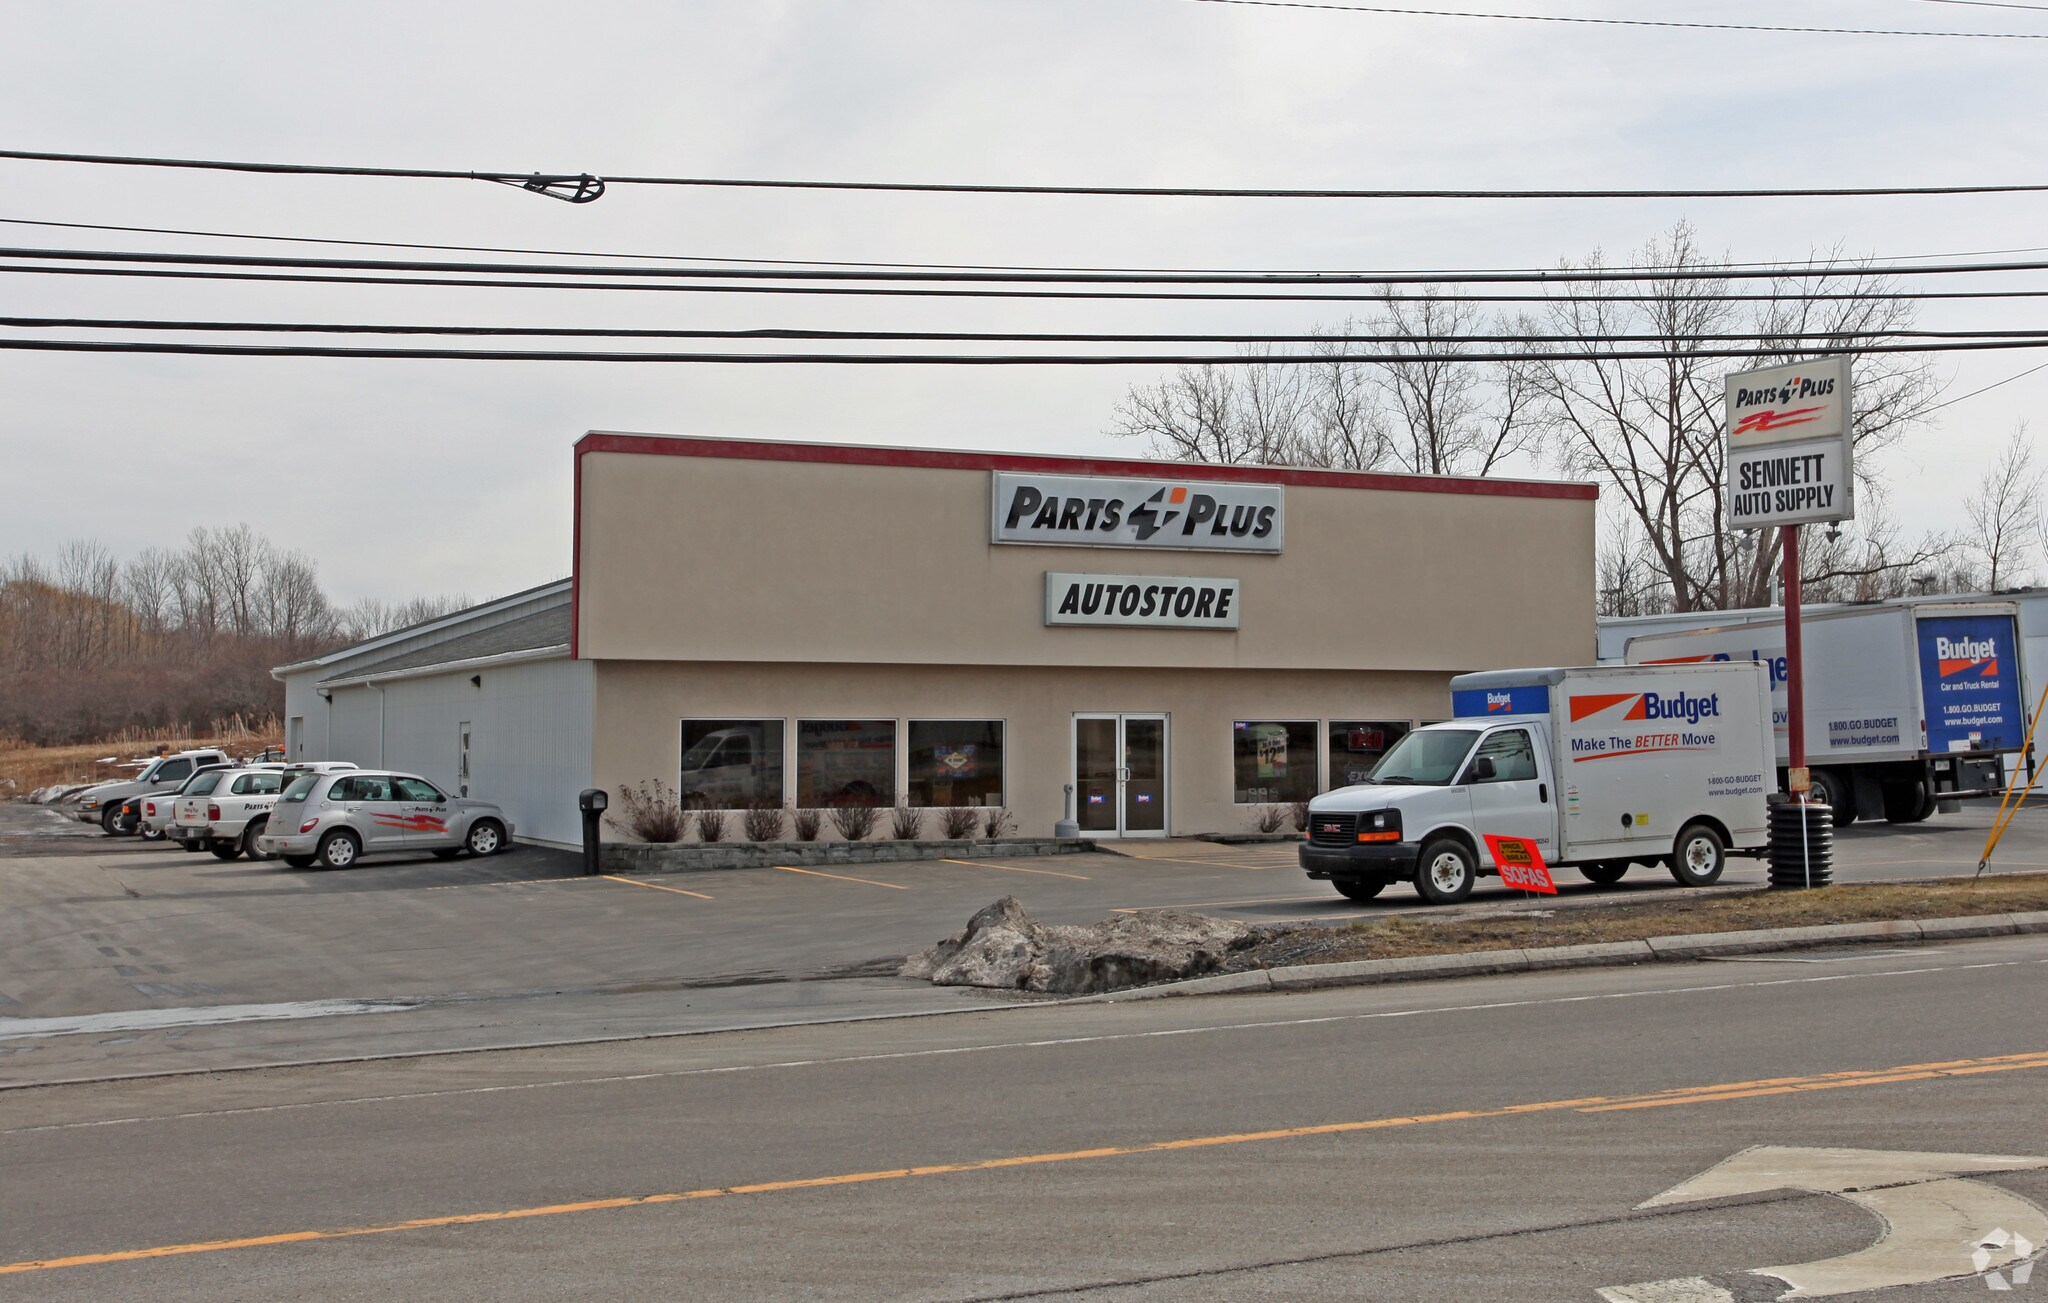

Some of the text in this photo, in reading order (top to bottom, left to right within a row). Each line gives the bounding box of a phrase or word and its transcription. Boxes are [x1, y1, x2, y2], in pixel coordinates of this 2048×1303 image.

[1735, 378, 1835, 408] PARTS PLUS
[1739, 453, 1825, 490] SENNETT
[1004, 486, 1276, 538] PARTS PLUS
[1733, 484, 1834, 516] AUTO SUPPLY
[1057, 583, 1234, 619] AUTOSTORE
[1936, 635, 1997, 665] Budget
[1487, 692, 1511, 706] Budget
[1940, 680, 2000, 692] Car and Truck Rental
[1644, 691, 1720, 725] Budget
[1944, 716, 2003, 727] www.budget.com
[1571, 733, 1715, 751] Make The BETTER Move
[1829, 734, 1900, 746] www.budget.com
[1708, 786, 1763, 797] www.budget.com
[1501, 865, 1549, 888] SOFAS
